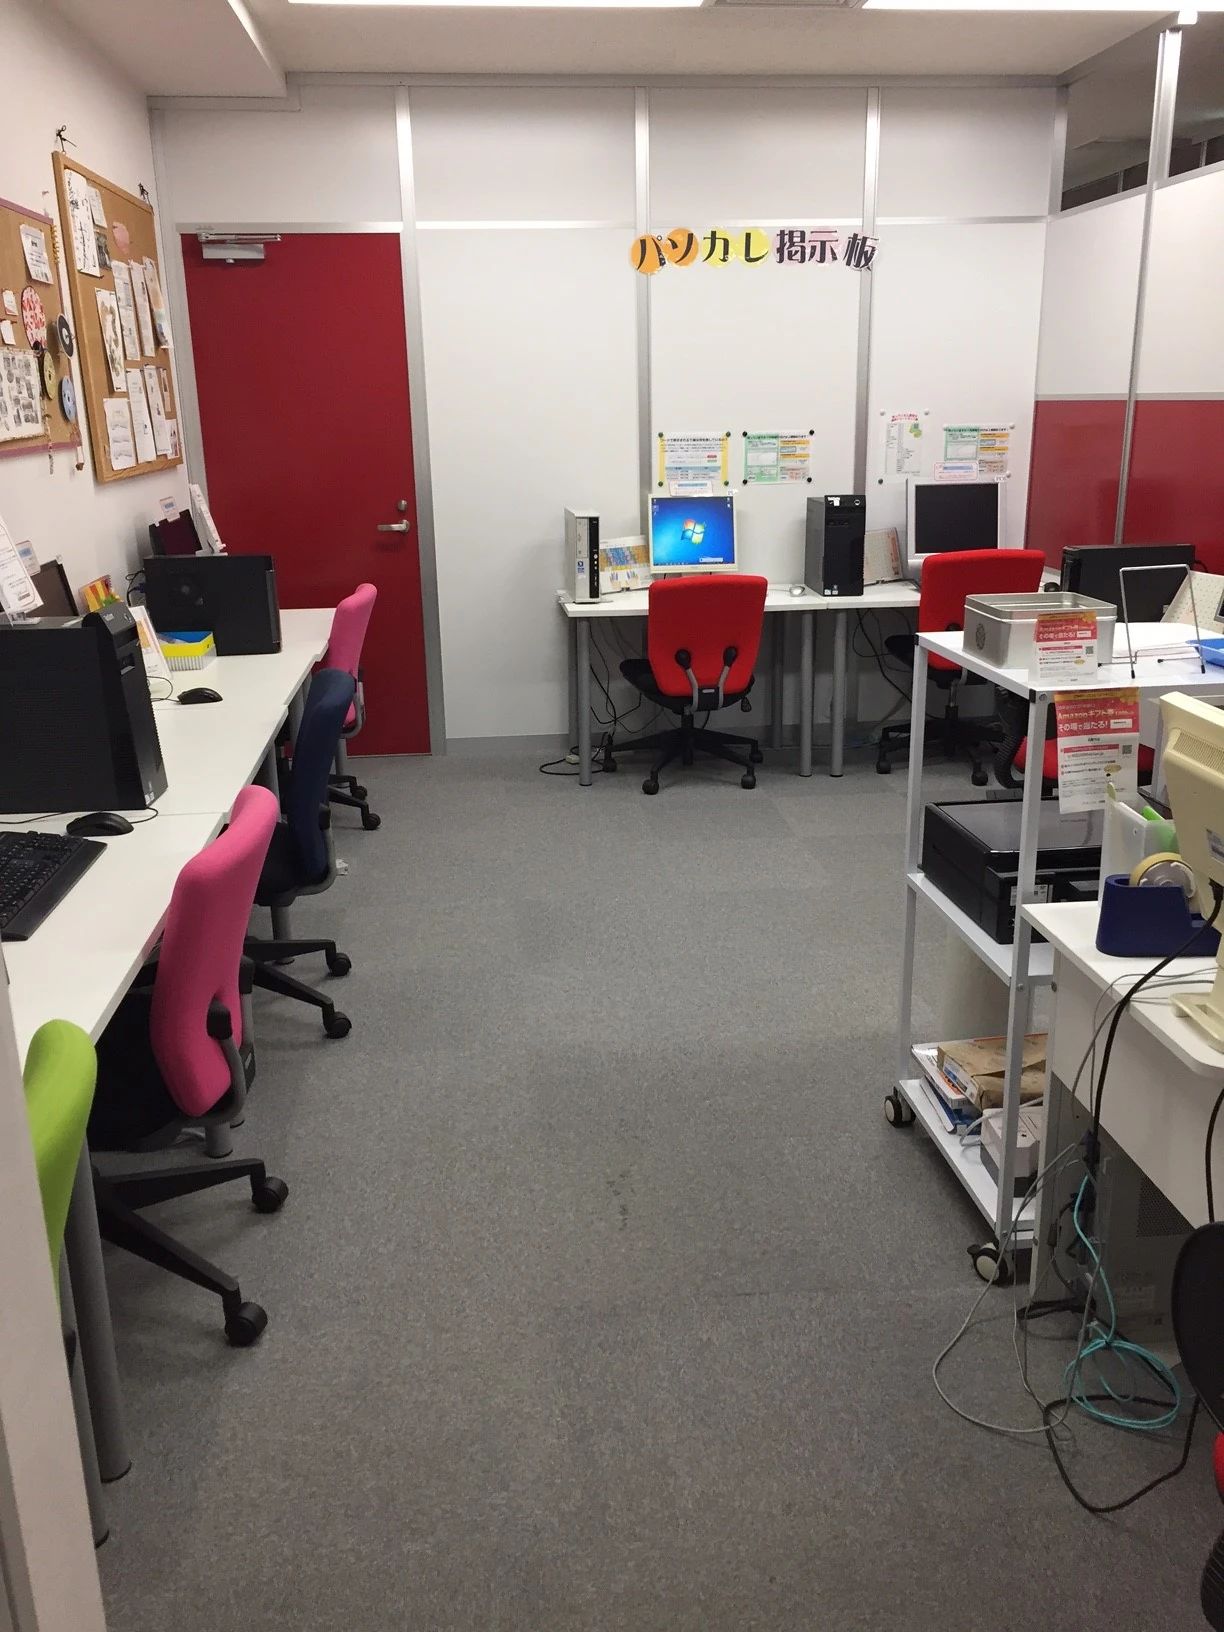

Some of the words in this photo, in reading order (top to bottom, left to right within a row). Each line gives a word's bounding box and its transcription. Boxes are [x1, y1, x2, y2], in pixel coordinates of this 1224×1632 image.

[636, 228, 880, 272] パソカレ掲示板
